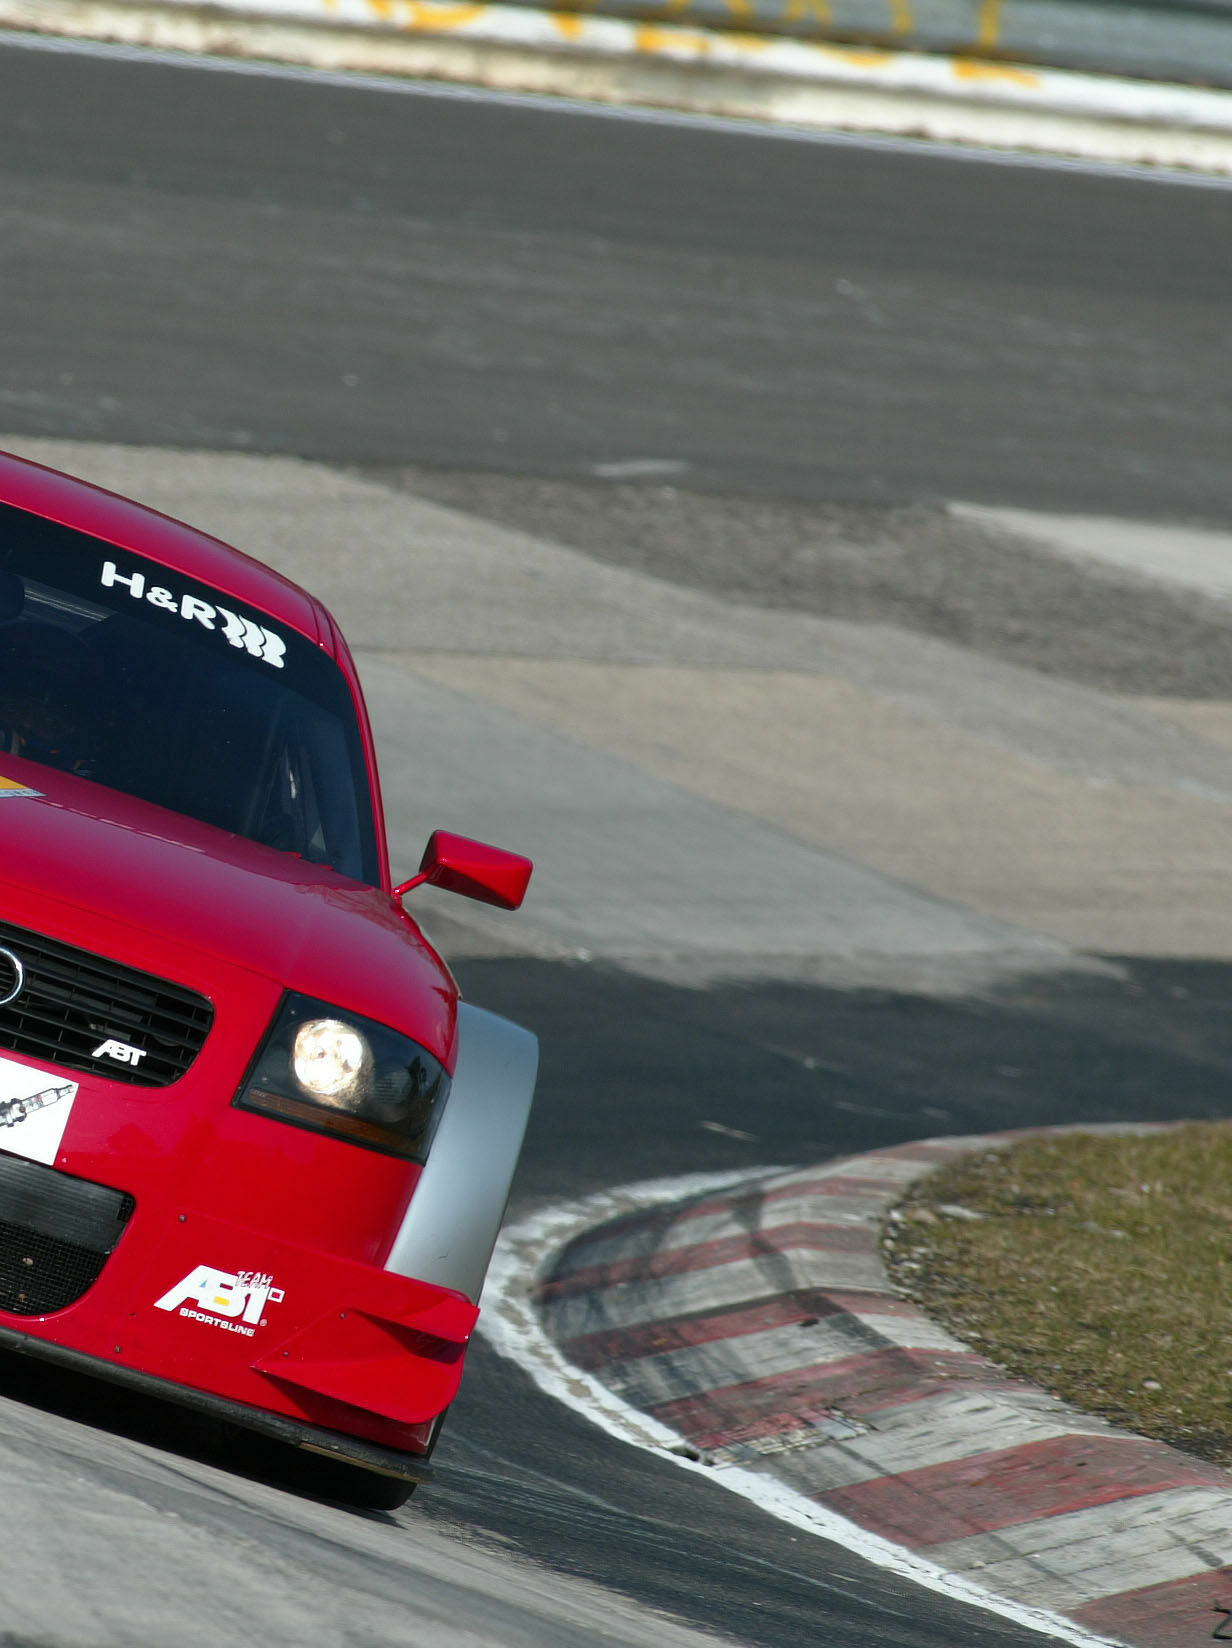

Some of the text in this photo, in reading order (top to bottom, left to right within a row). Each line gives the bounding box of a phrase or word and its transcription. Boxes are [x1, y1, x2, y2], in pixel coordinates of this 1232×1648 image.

[91, 1039, 147, 1067] ABT
[235, 1270, 274, 1289] TEAM
[153, 1264, 285, 1325] ABT
[179, 1307, 256, 1337] SPORTSLINE
